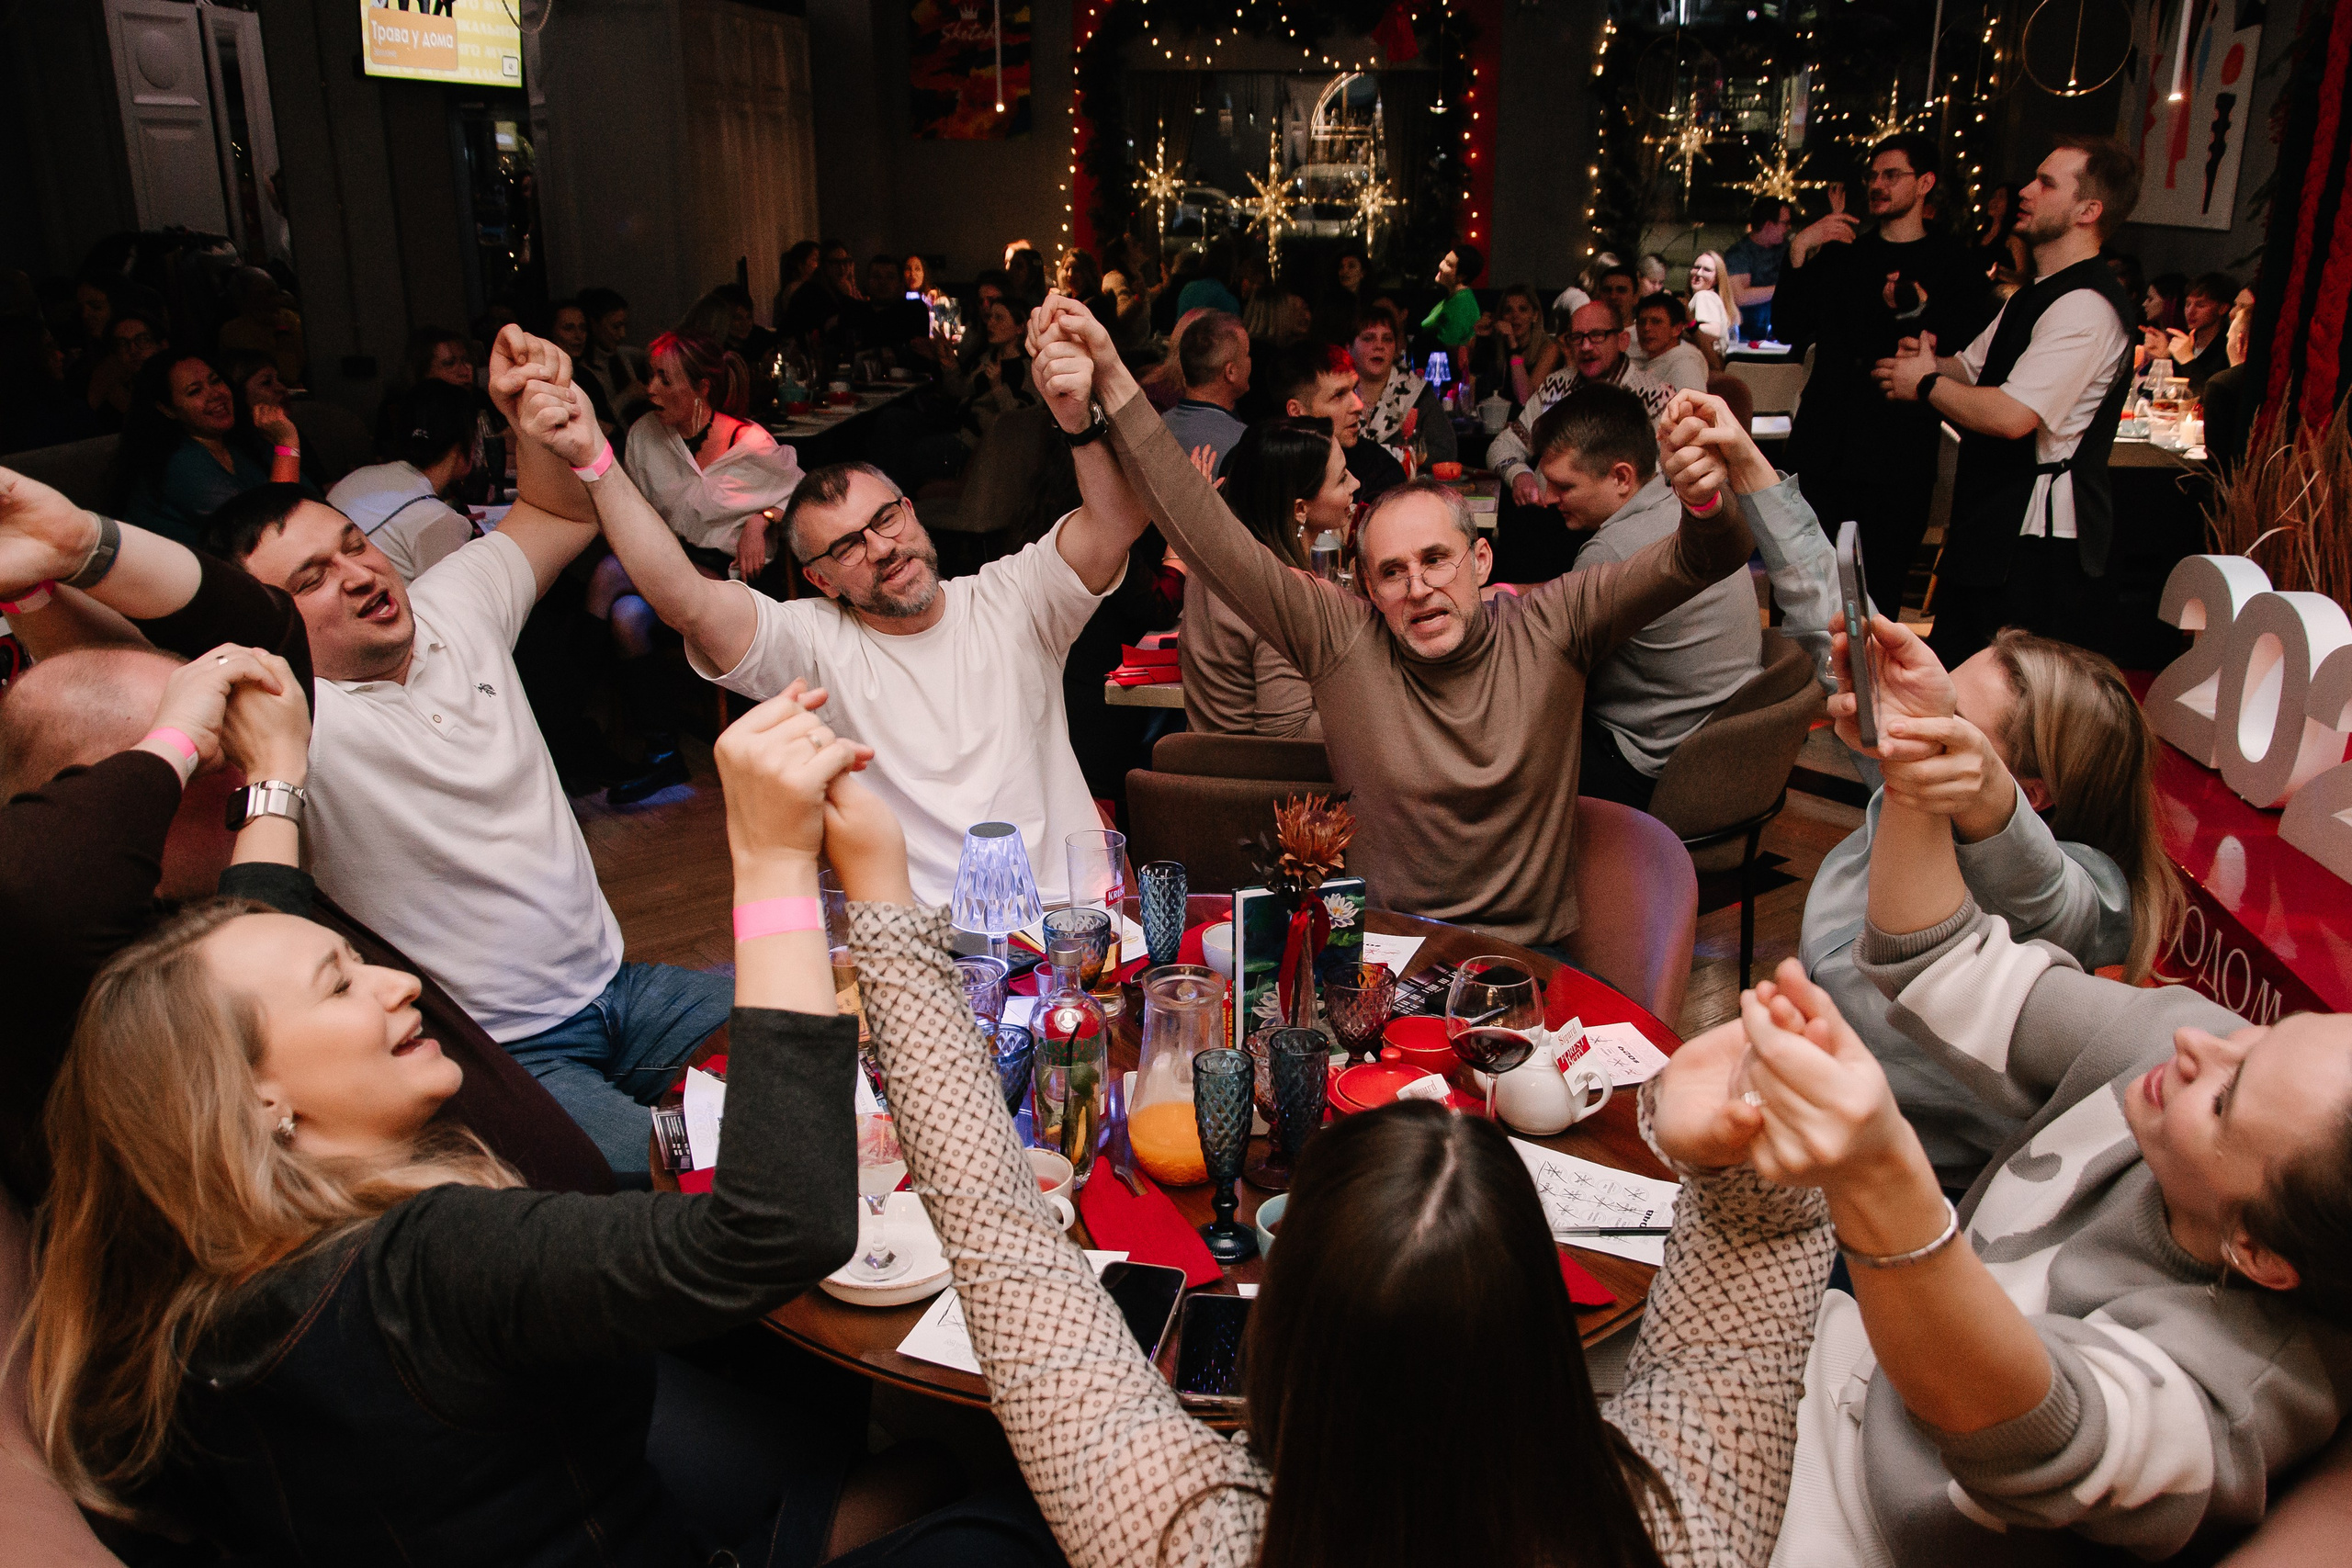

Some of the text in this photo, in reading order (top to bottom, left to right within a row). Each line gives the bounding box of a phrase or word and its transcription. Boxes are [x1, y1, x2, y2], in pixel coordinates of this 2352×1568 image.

[371, 20, 454, 49] Трава у дома
[2179, 905, 2283, 1026] ОДОМ
[1558, 1023, 1577, 1046] Sigurd
